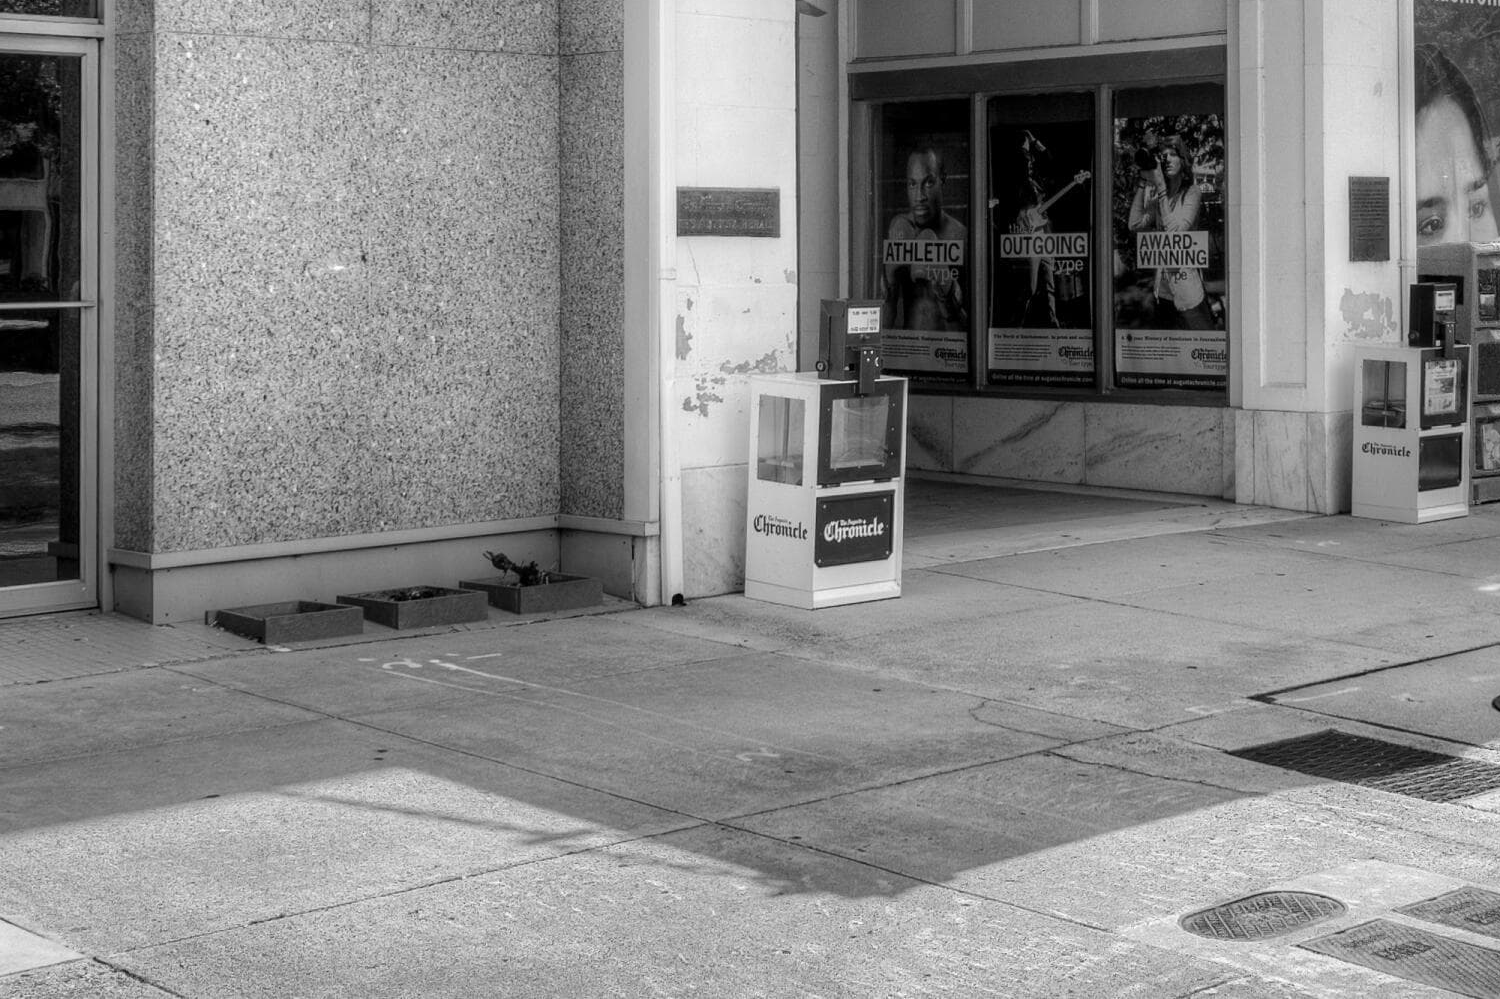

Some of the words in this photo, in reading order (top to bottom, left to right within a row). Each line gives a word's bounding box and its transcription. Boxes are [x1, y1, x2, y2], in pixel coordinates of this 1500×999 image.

[1002, 235, 1086, 256] OUTGOING
[1140, 233, 1198, 250] AWARD-
[886, 242, 961, 263] ATHLETIC
[1139, 249, 1208, 267] WINNING
[926, 265, 960, 285] type
[1362, 441, 1411, 457] Chronicle
[753, 514, 808, 541] Chronicle
[823, 515, 885, 543] Chronicle
